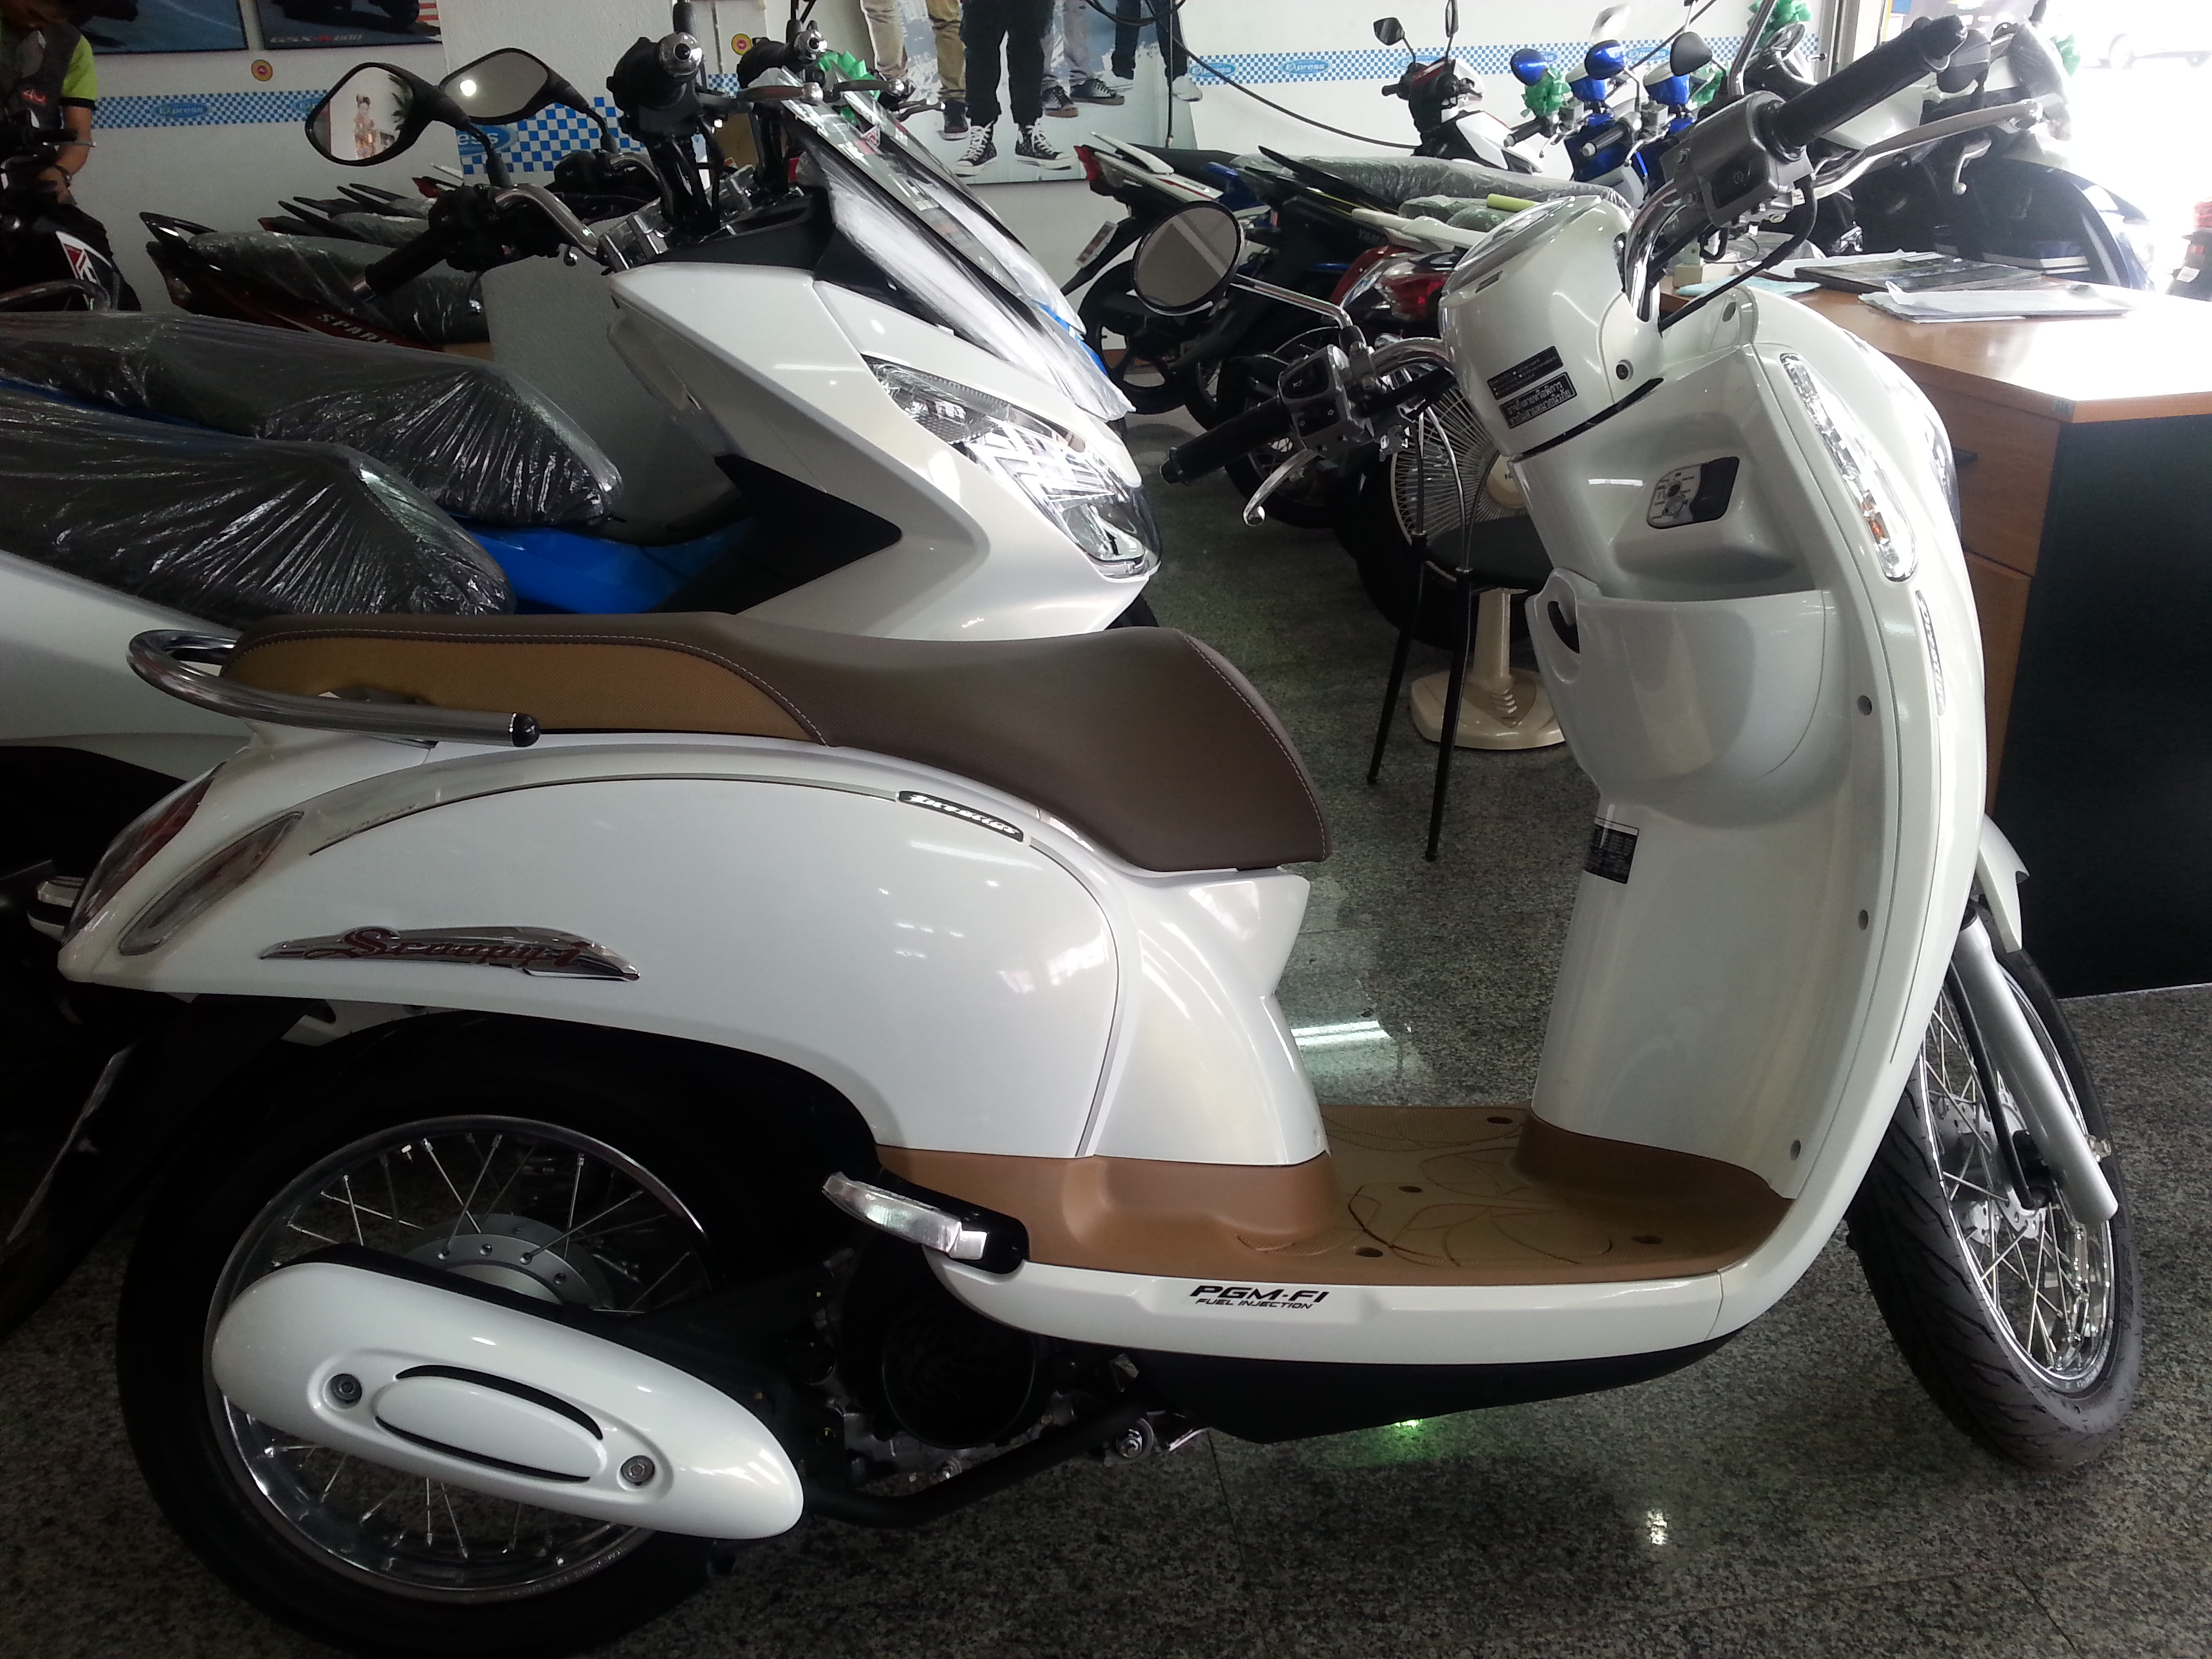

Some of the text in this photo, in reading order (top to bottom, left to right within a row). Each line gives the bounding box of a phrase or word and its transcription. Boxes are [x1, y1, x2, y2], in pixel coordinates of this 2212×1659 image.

[1189, 1285, 1330, 1303] PGM-FI
[1195, 1298, 1313, 1309] FUEL INJECTION
